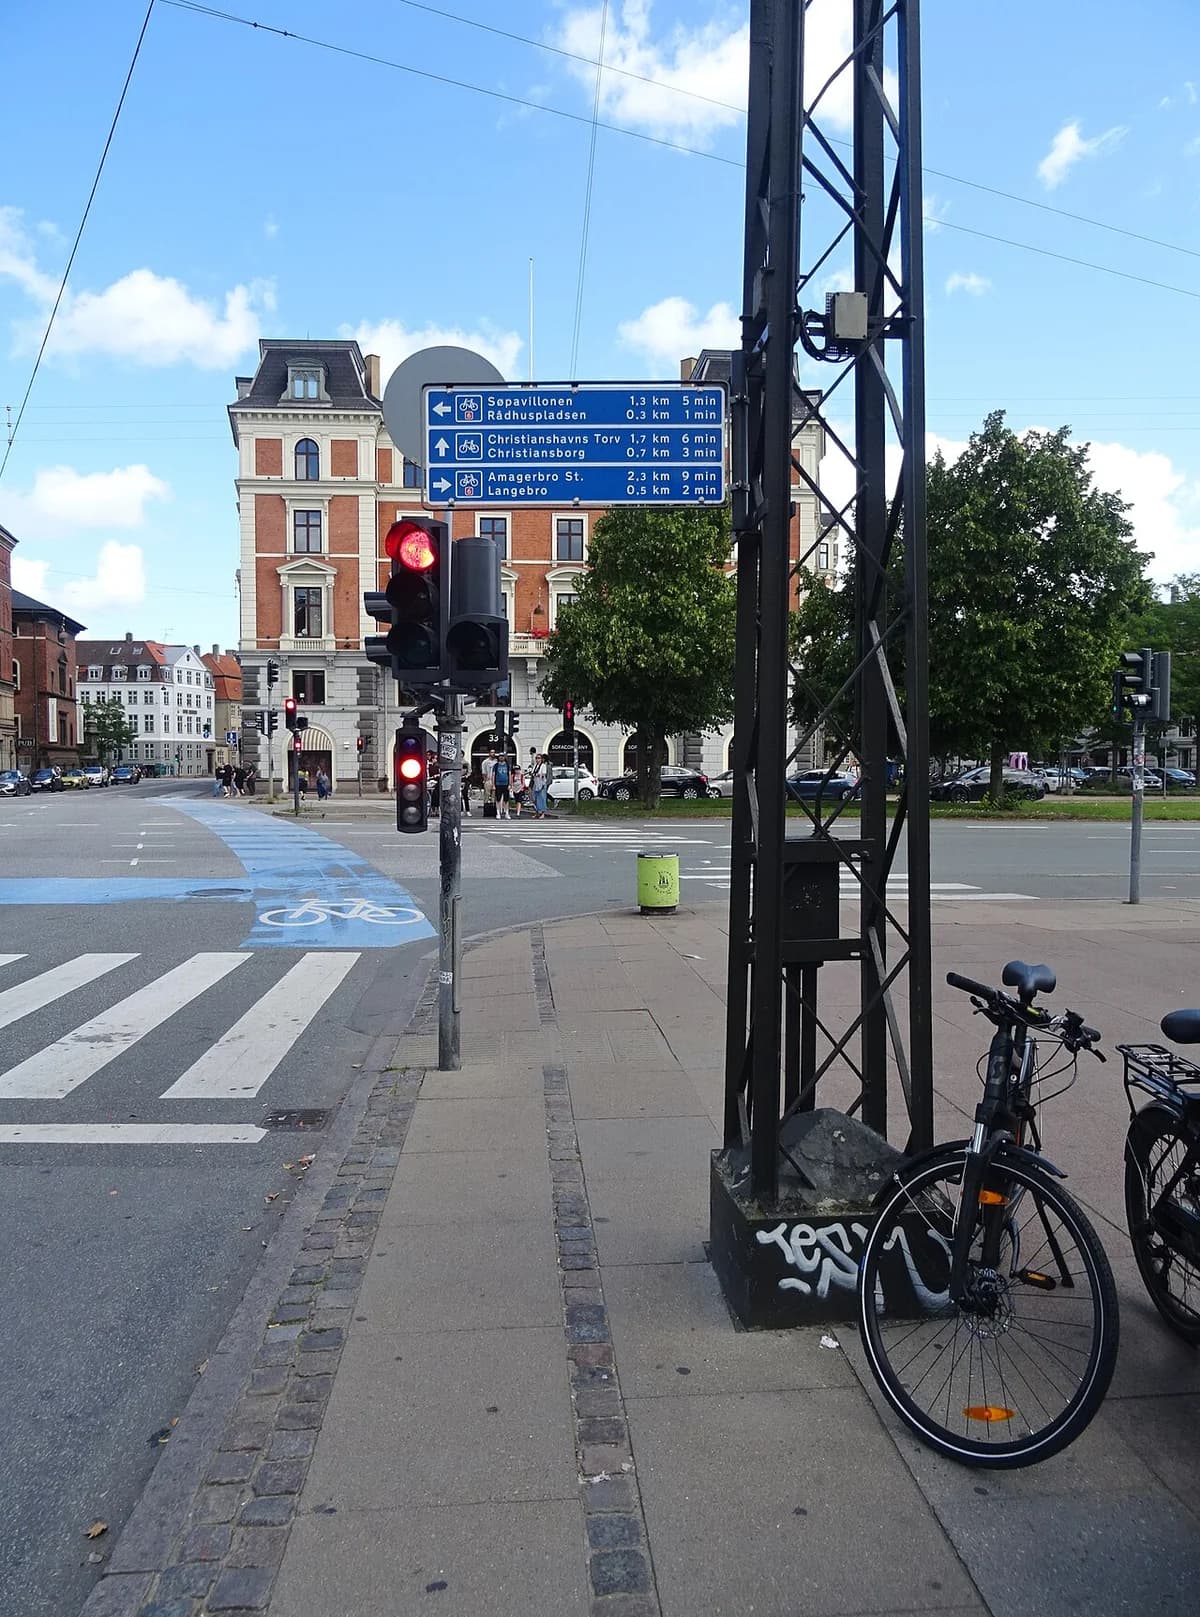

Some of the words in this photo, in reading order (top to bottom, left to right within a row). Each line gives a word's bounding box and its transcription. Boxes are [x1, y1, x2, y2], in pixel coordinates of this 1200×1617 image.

[487, 396, 573, 408] Søpavillonen
[629, 395, 646, 405] 1.3
[653, 395, 670, 405] km
[682, 395, 690, 405] 5
[694, 395, 716, 405] min
[487, 410, 586, 421] Rådhuspladsen
[626, 409, 646, 419] 0.3
[653, 409, 670, 419] km
[684, 409, 690, 419] 1
[694, 409, 716, 419] min
[487, 434, 589, 445] Christianshavns
[593, 434, 621, 444] Torv
[629, 433, 646, 443] 1.7
[653, 433, 670, 443] km
[682, 433, 690, 443] 6
[694, 433, 716, 443] min
[487, 447, 585, 459] Christiansborg
[626, 447, 646, 457] 0.7
[653, 447, 670, 457] km
[682, 447, 690, 457] 3
[694, 447, 716, 457] min
[487, 471, 559, 483] Amagerbro
[565, 471, 584, 481] St.
[627, 471, 646, 481] 2.3
[653, 471, 670, 481] km
[681, 471, 690, 481] 9
[694, 471, 716, 481] min
[488, 485, 548, 497] Langebro
[626, 485, 646, 495] 0.5
[653, 485, 670, 495] km
[682, 485, 690, 495] 2
[694, 485, 716, 495] min
[488, 734, 499, 742] 33
